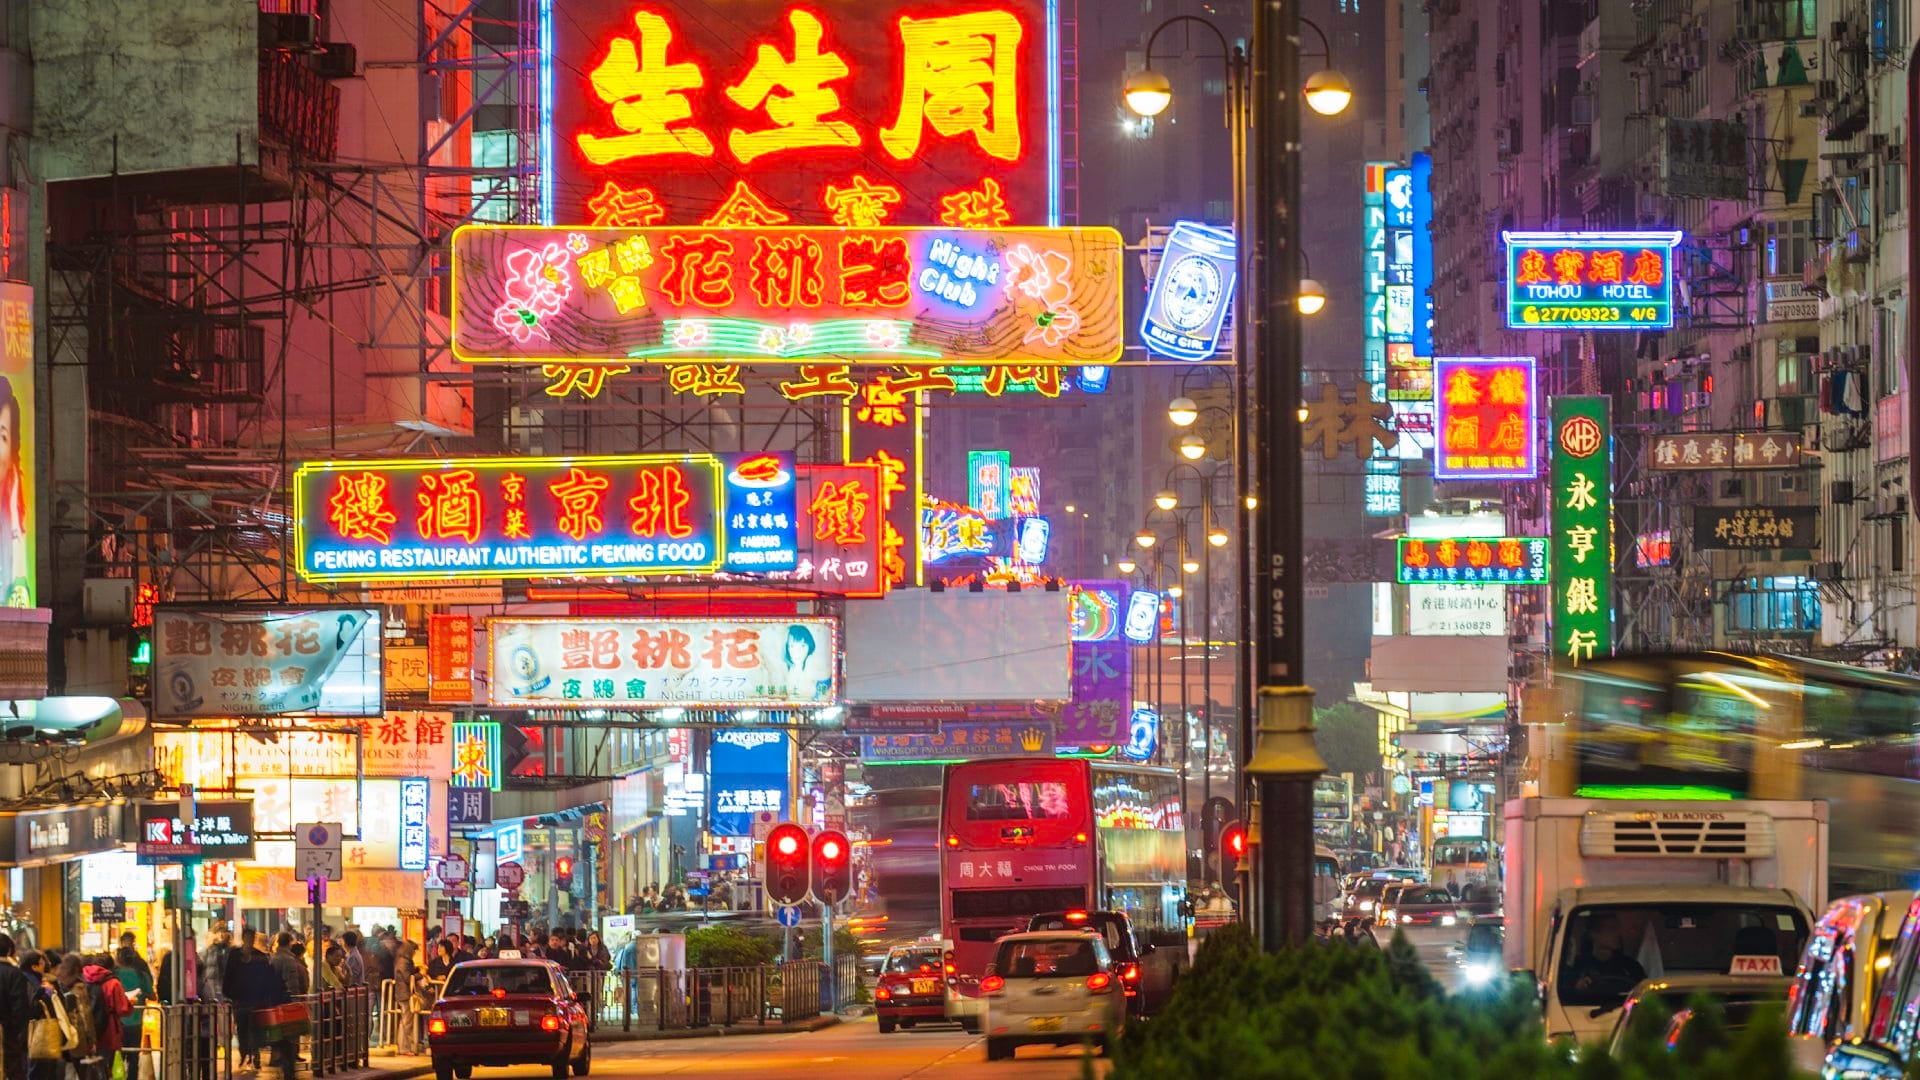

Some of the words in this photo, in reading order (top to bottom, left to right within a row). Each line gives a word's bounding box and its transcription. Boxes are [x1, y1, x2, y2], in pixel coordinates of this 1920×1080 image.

[928, 238, 1000, 286] Night
[918, 267, 977, 308] Club
[1527, 285, 1582, 298] TOHOU
[1602, 285, 1653, 299] HOTEL
[1540, 307, 1620, 321] 27709323
[1150, 325, 1178, 345] BLUE
[1177, 337, 1204, 350] GIRL
[740, 535, 781, 549] FAMOUS
[313, 549, 376, 569] PEKING
[380, 547, 490, 567] RESTAURANT
[494, 545, 589, 566] AUTHENTIC
[592, 543, 654, 564] PEKING
[657, 542, 707, 562] FOOD
[728, 550, 765, 564] PEKING
[766, 549, 794, 562] DUCK
[1272, 554, 1285, 580] DF
[1565, 472, 1599, 668] 永亨銀行
[661, 689, 703, 700] NIGHT
[710, 689, 746, 700] CLUB
[222, 703, 255, 713] NIGHT
[881, 703, 965, 714] www.dance.com.hk
[717, 731, 781, 743] LONGINES
[873, 747, 918, 756] WINDSOR
[921, 746, 963, 755] PALACE
[1683, 812, 1725, 821] MOTORS
[201, 834, 222, 845] Kee
[222, 833, 249, 845] Tailor
[959, 861, 1013, 878] 周大福
[1736, 958, 1778, 972] TAXI
